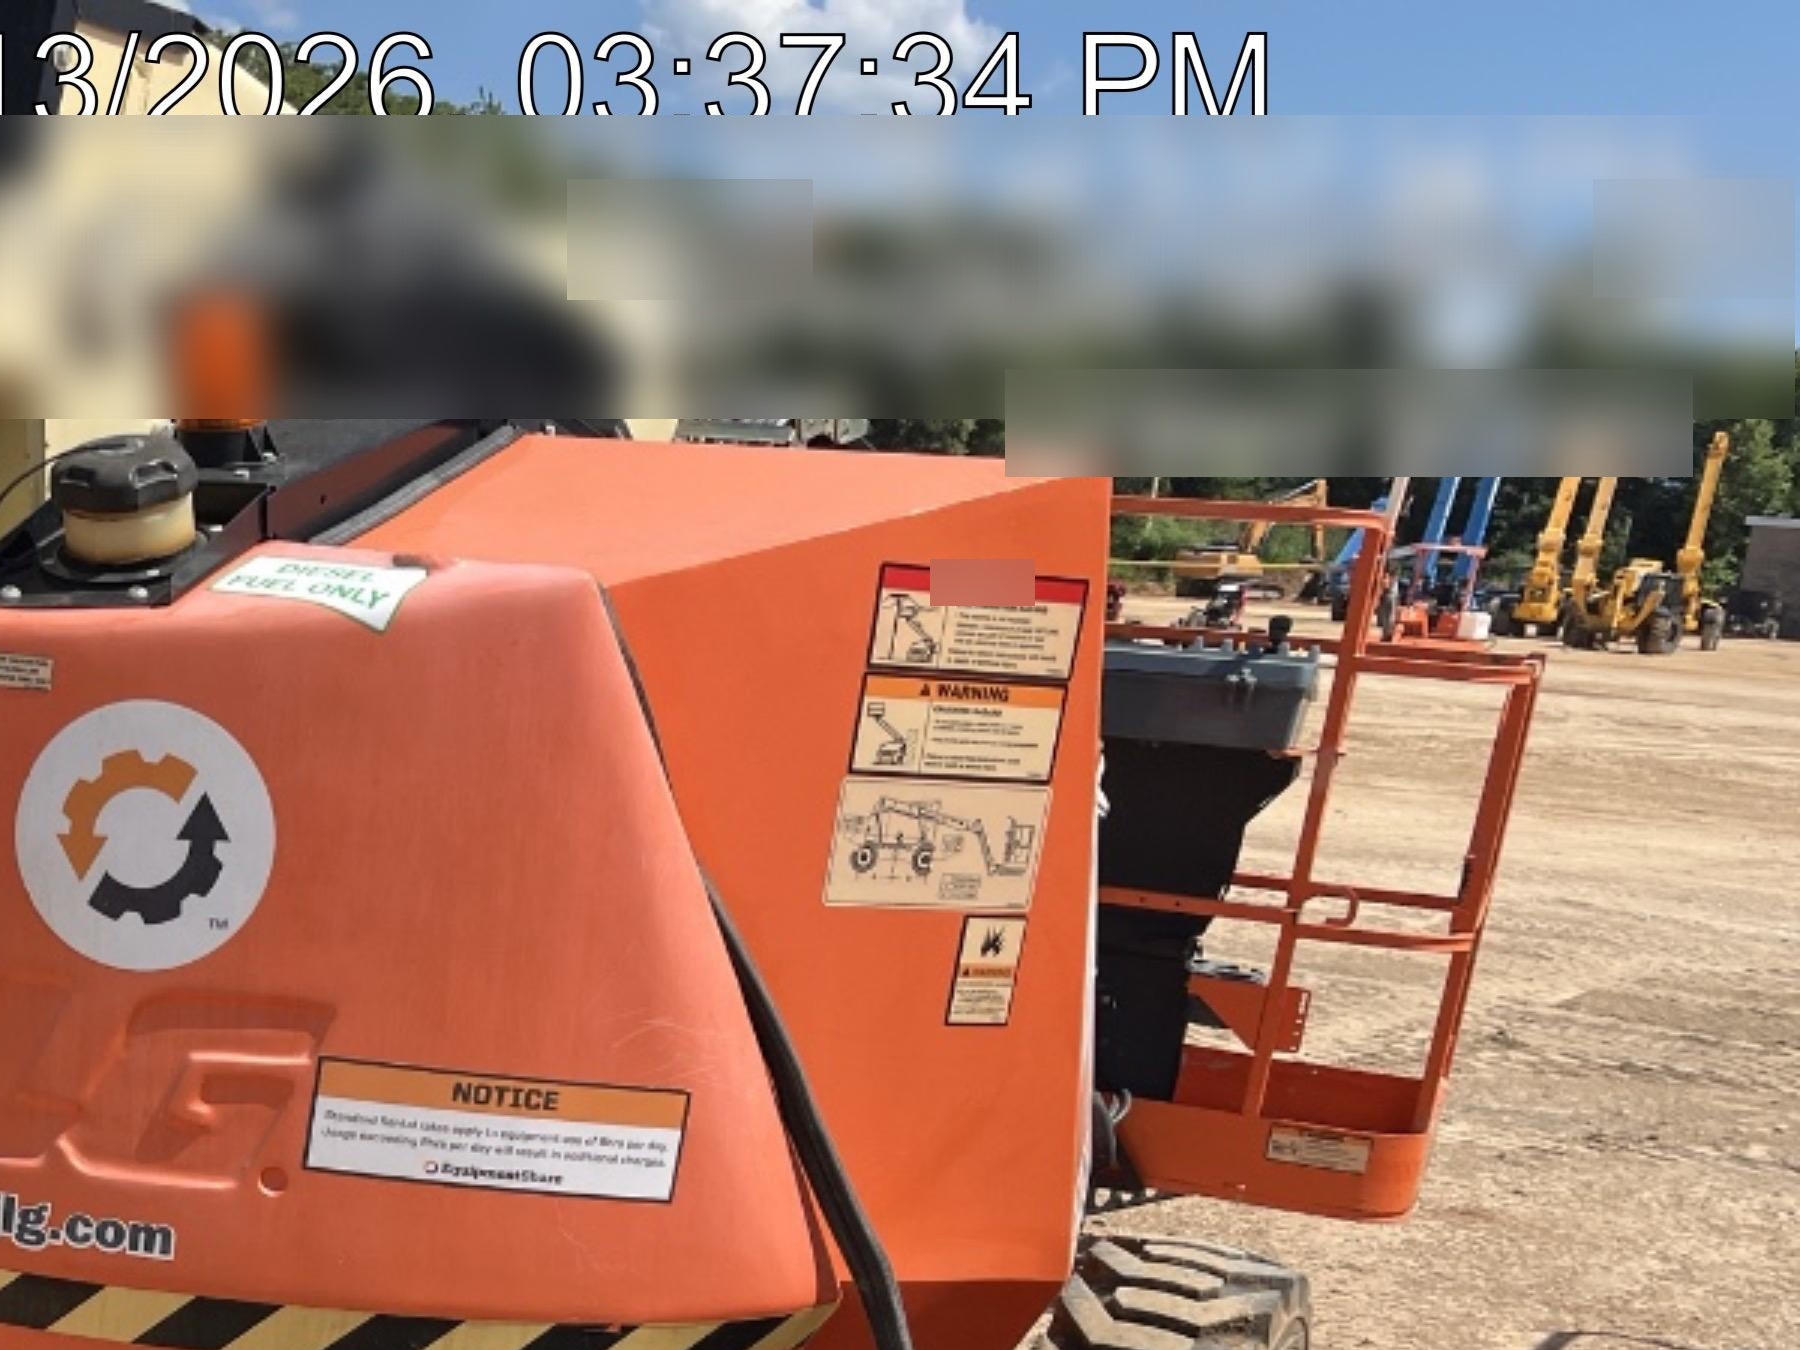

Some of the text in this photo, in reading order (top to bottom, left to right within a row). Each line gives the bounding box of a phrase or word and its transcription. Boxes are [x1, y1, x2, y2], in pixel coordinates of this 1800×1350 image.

[308, 583, 391, 609] ONLY
[938, 684, 1009, 702] WARNING
[452, 1081, 560, 1111] NOTICE
